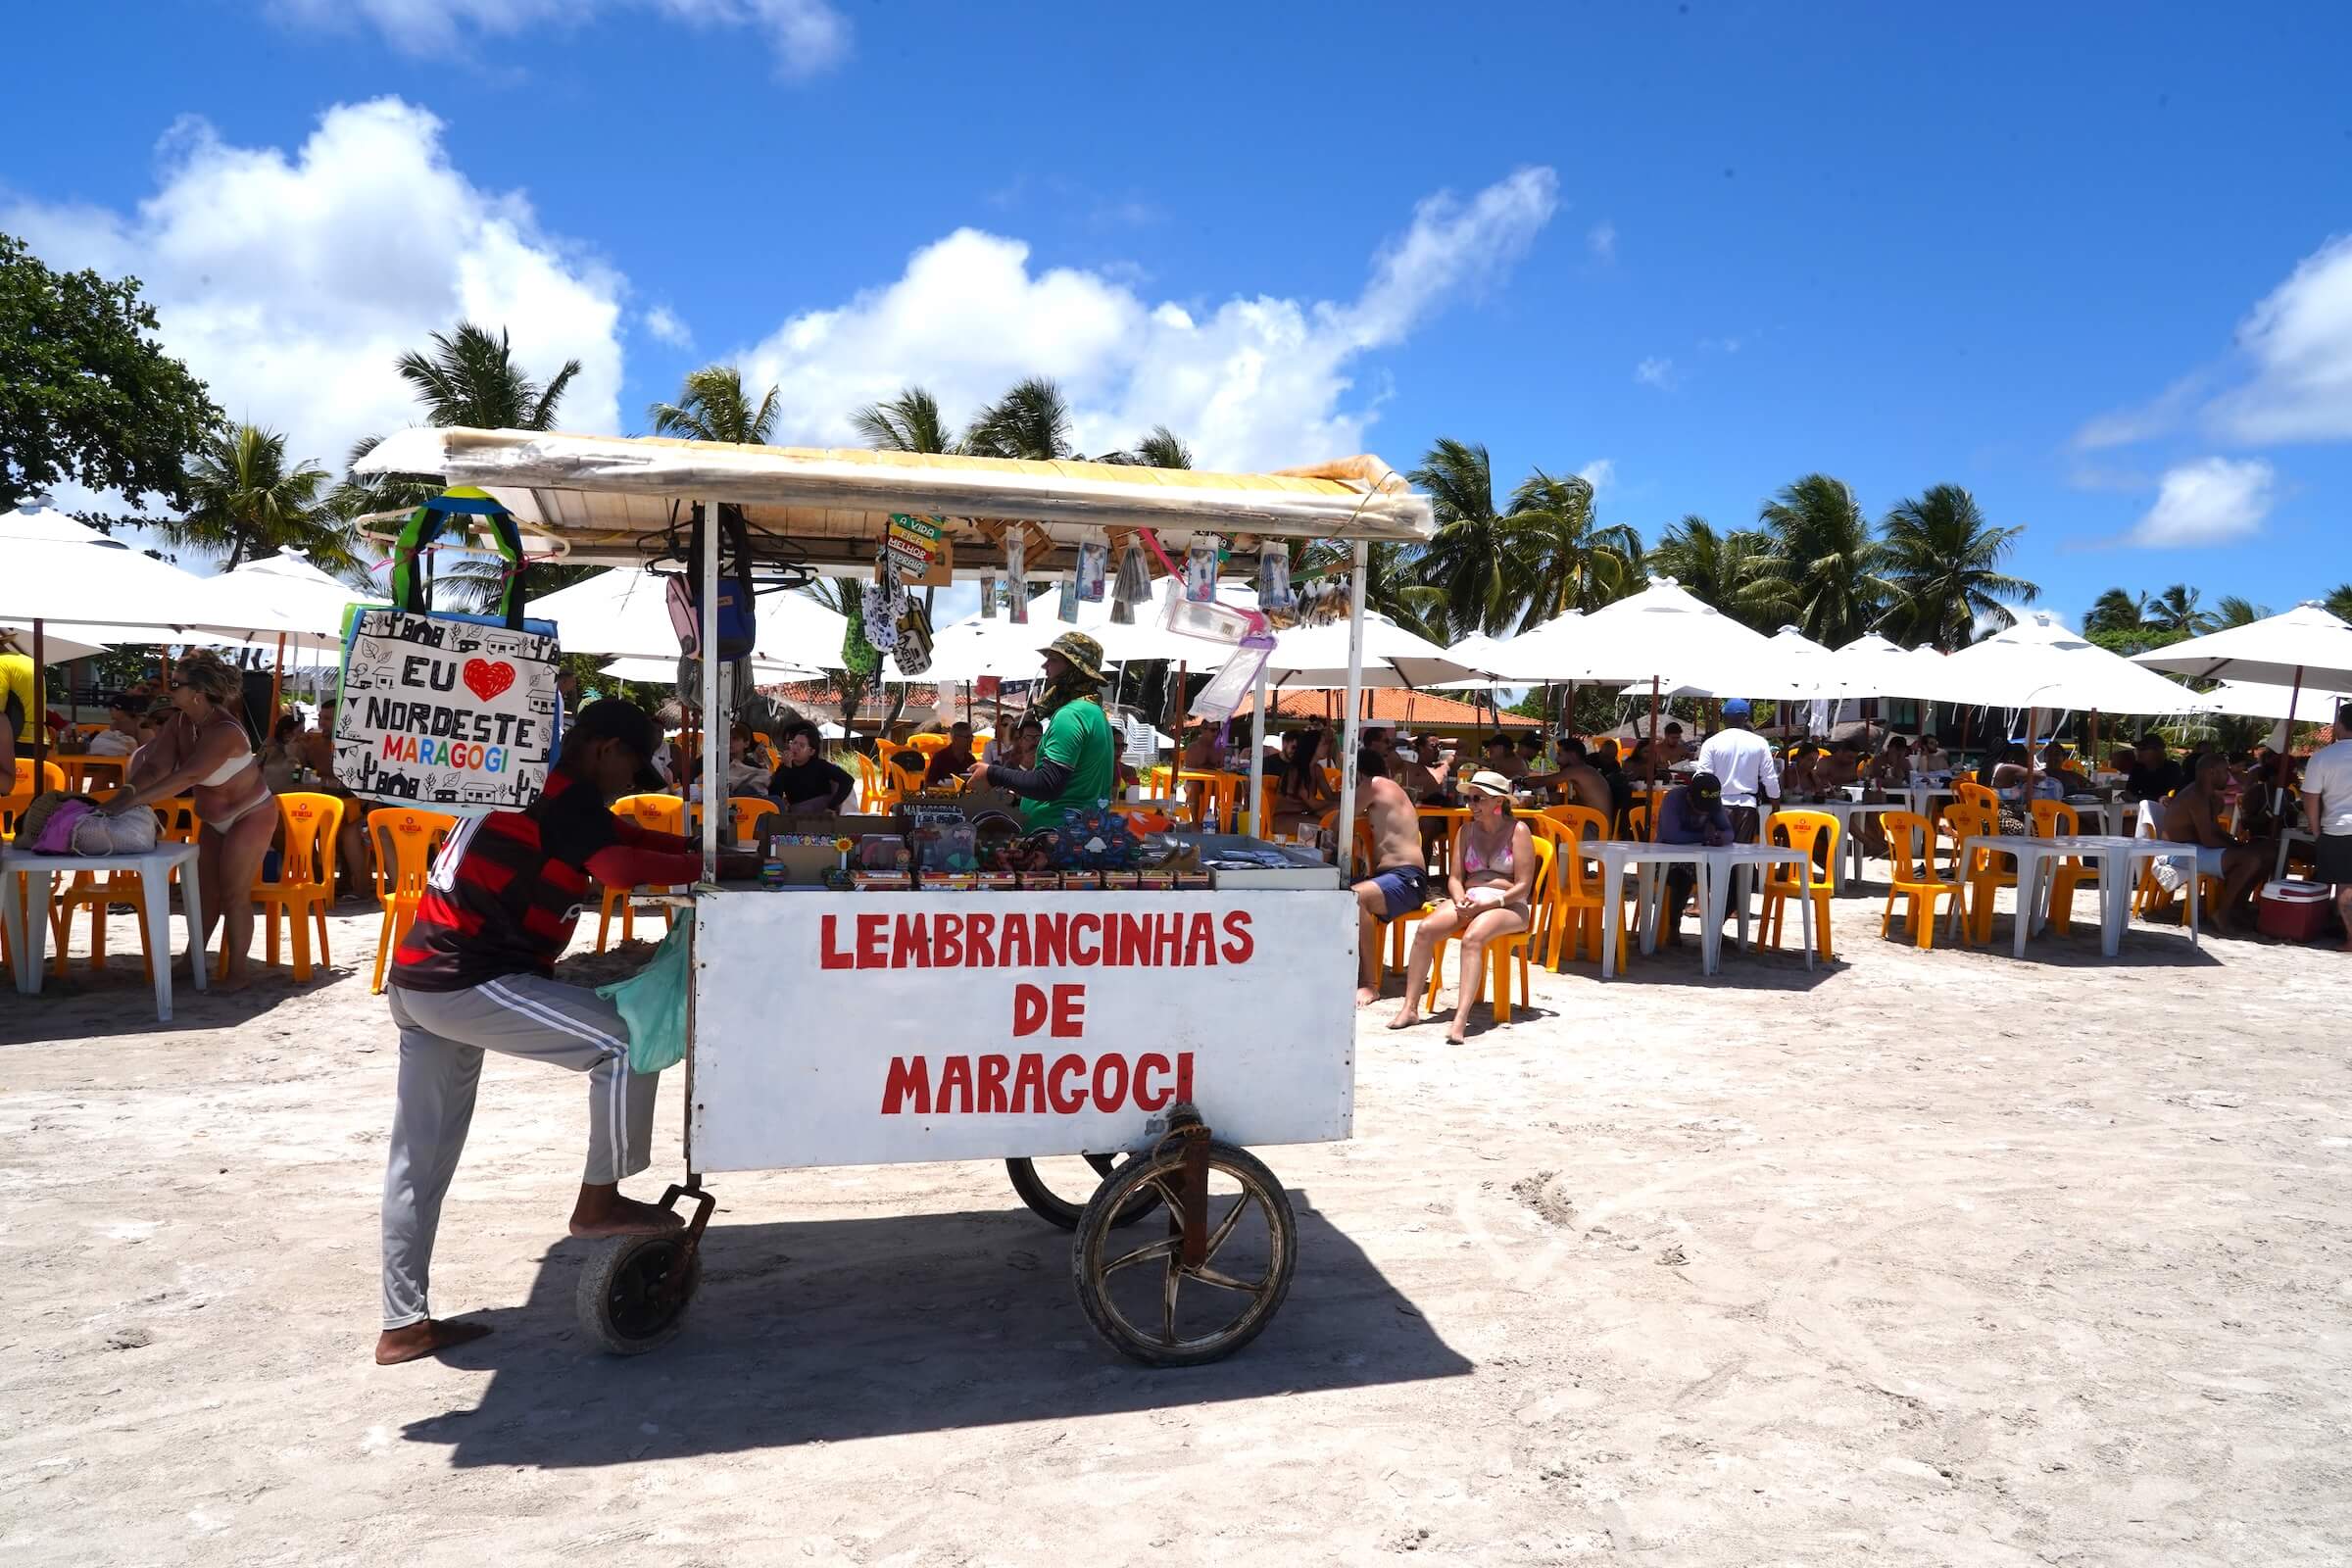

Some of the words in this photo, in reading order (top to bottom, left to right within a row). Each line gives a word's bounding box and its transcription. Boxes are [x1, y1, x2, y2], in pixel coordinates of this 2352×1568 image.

[901, 530, 923, 546] FICA
[911, 520, 935, 538] VIDA
[888, 537, 926, 560] MELHOR
[896, 555, 923, 570] PRAIA
[401, 655, 457, 692] EU
[365, 696, 536, 749] NORDESTE
[382, 734, 509, 773] MARAGOGI
[820, 909, 1254, 969] LEMBRANCINHAS
[1012, 983, 1086, 1038] DE
[880, 1051, 1194, 1114] MARAGOGI
